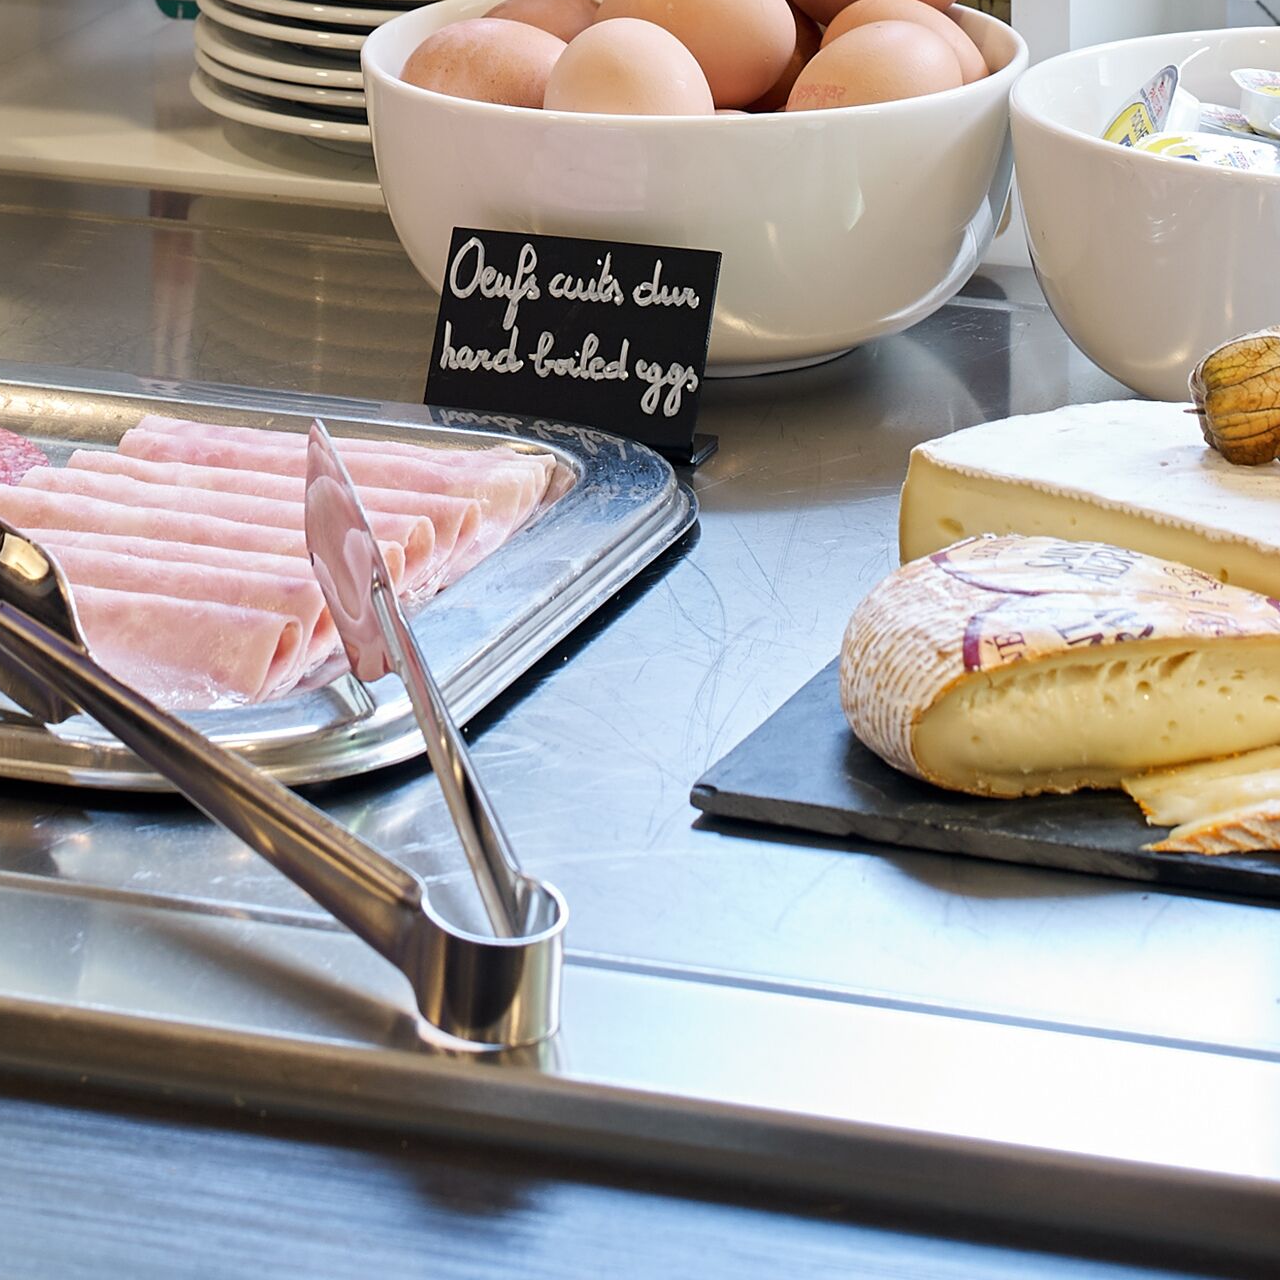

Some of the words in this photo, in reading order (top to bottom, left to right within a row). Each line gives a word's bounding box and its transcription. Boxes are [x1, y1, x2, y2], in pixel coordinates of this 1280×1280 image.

[548, 252, 624, 306] cuits
[440, 320, 524, 373] hard
[528, 331, 629, 381] boiled
[635, 358, 699, 417] eggs
